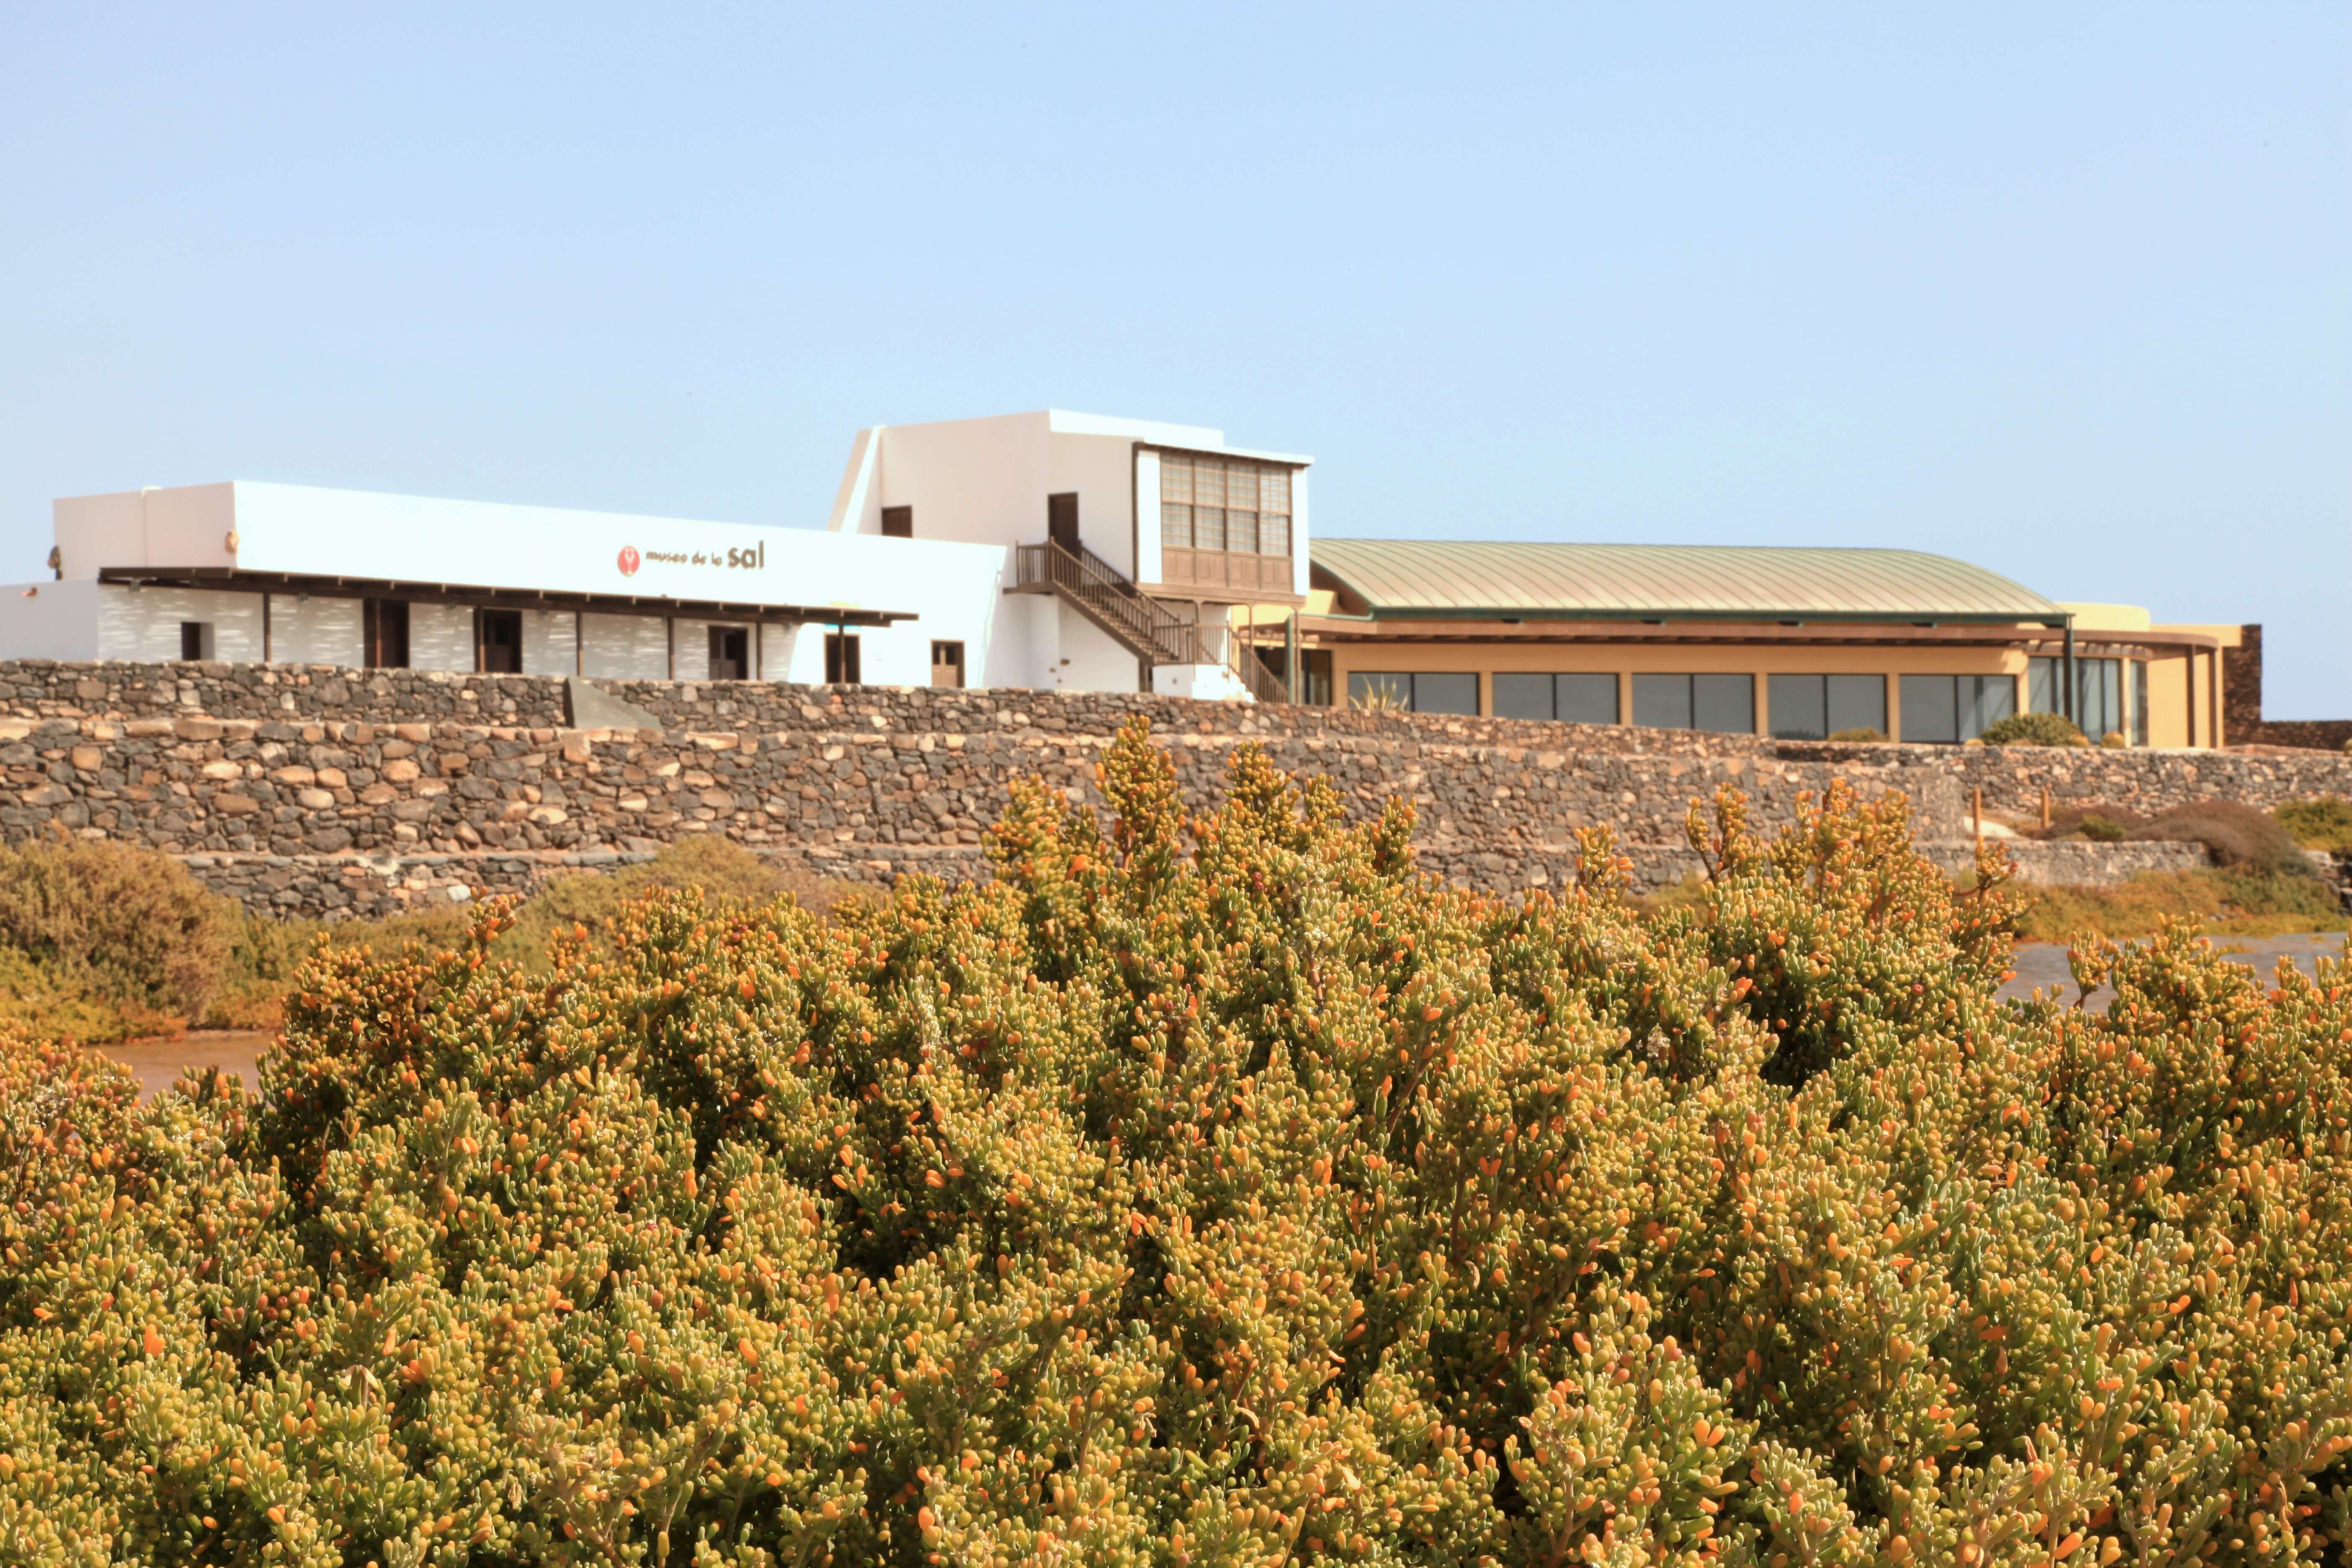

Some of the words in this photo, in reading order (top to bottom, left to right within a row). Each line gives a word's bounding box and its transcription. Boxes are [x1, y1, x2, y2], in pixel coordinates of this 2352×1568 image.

[645, 551, 688, 564] museo
[691, 550, 707, 565] de
[727, 539, 764, 569] sal
